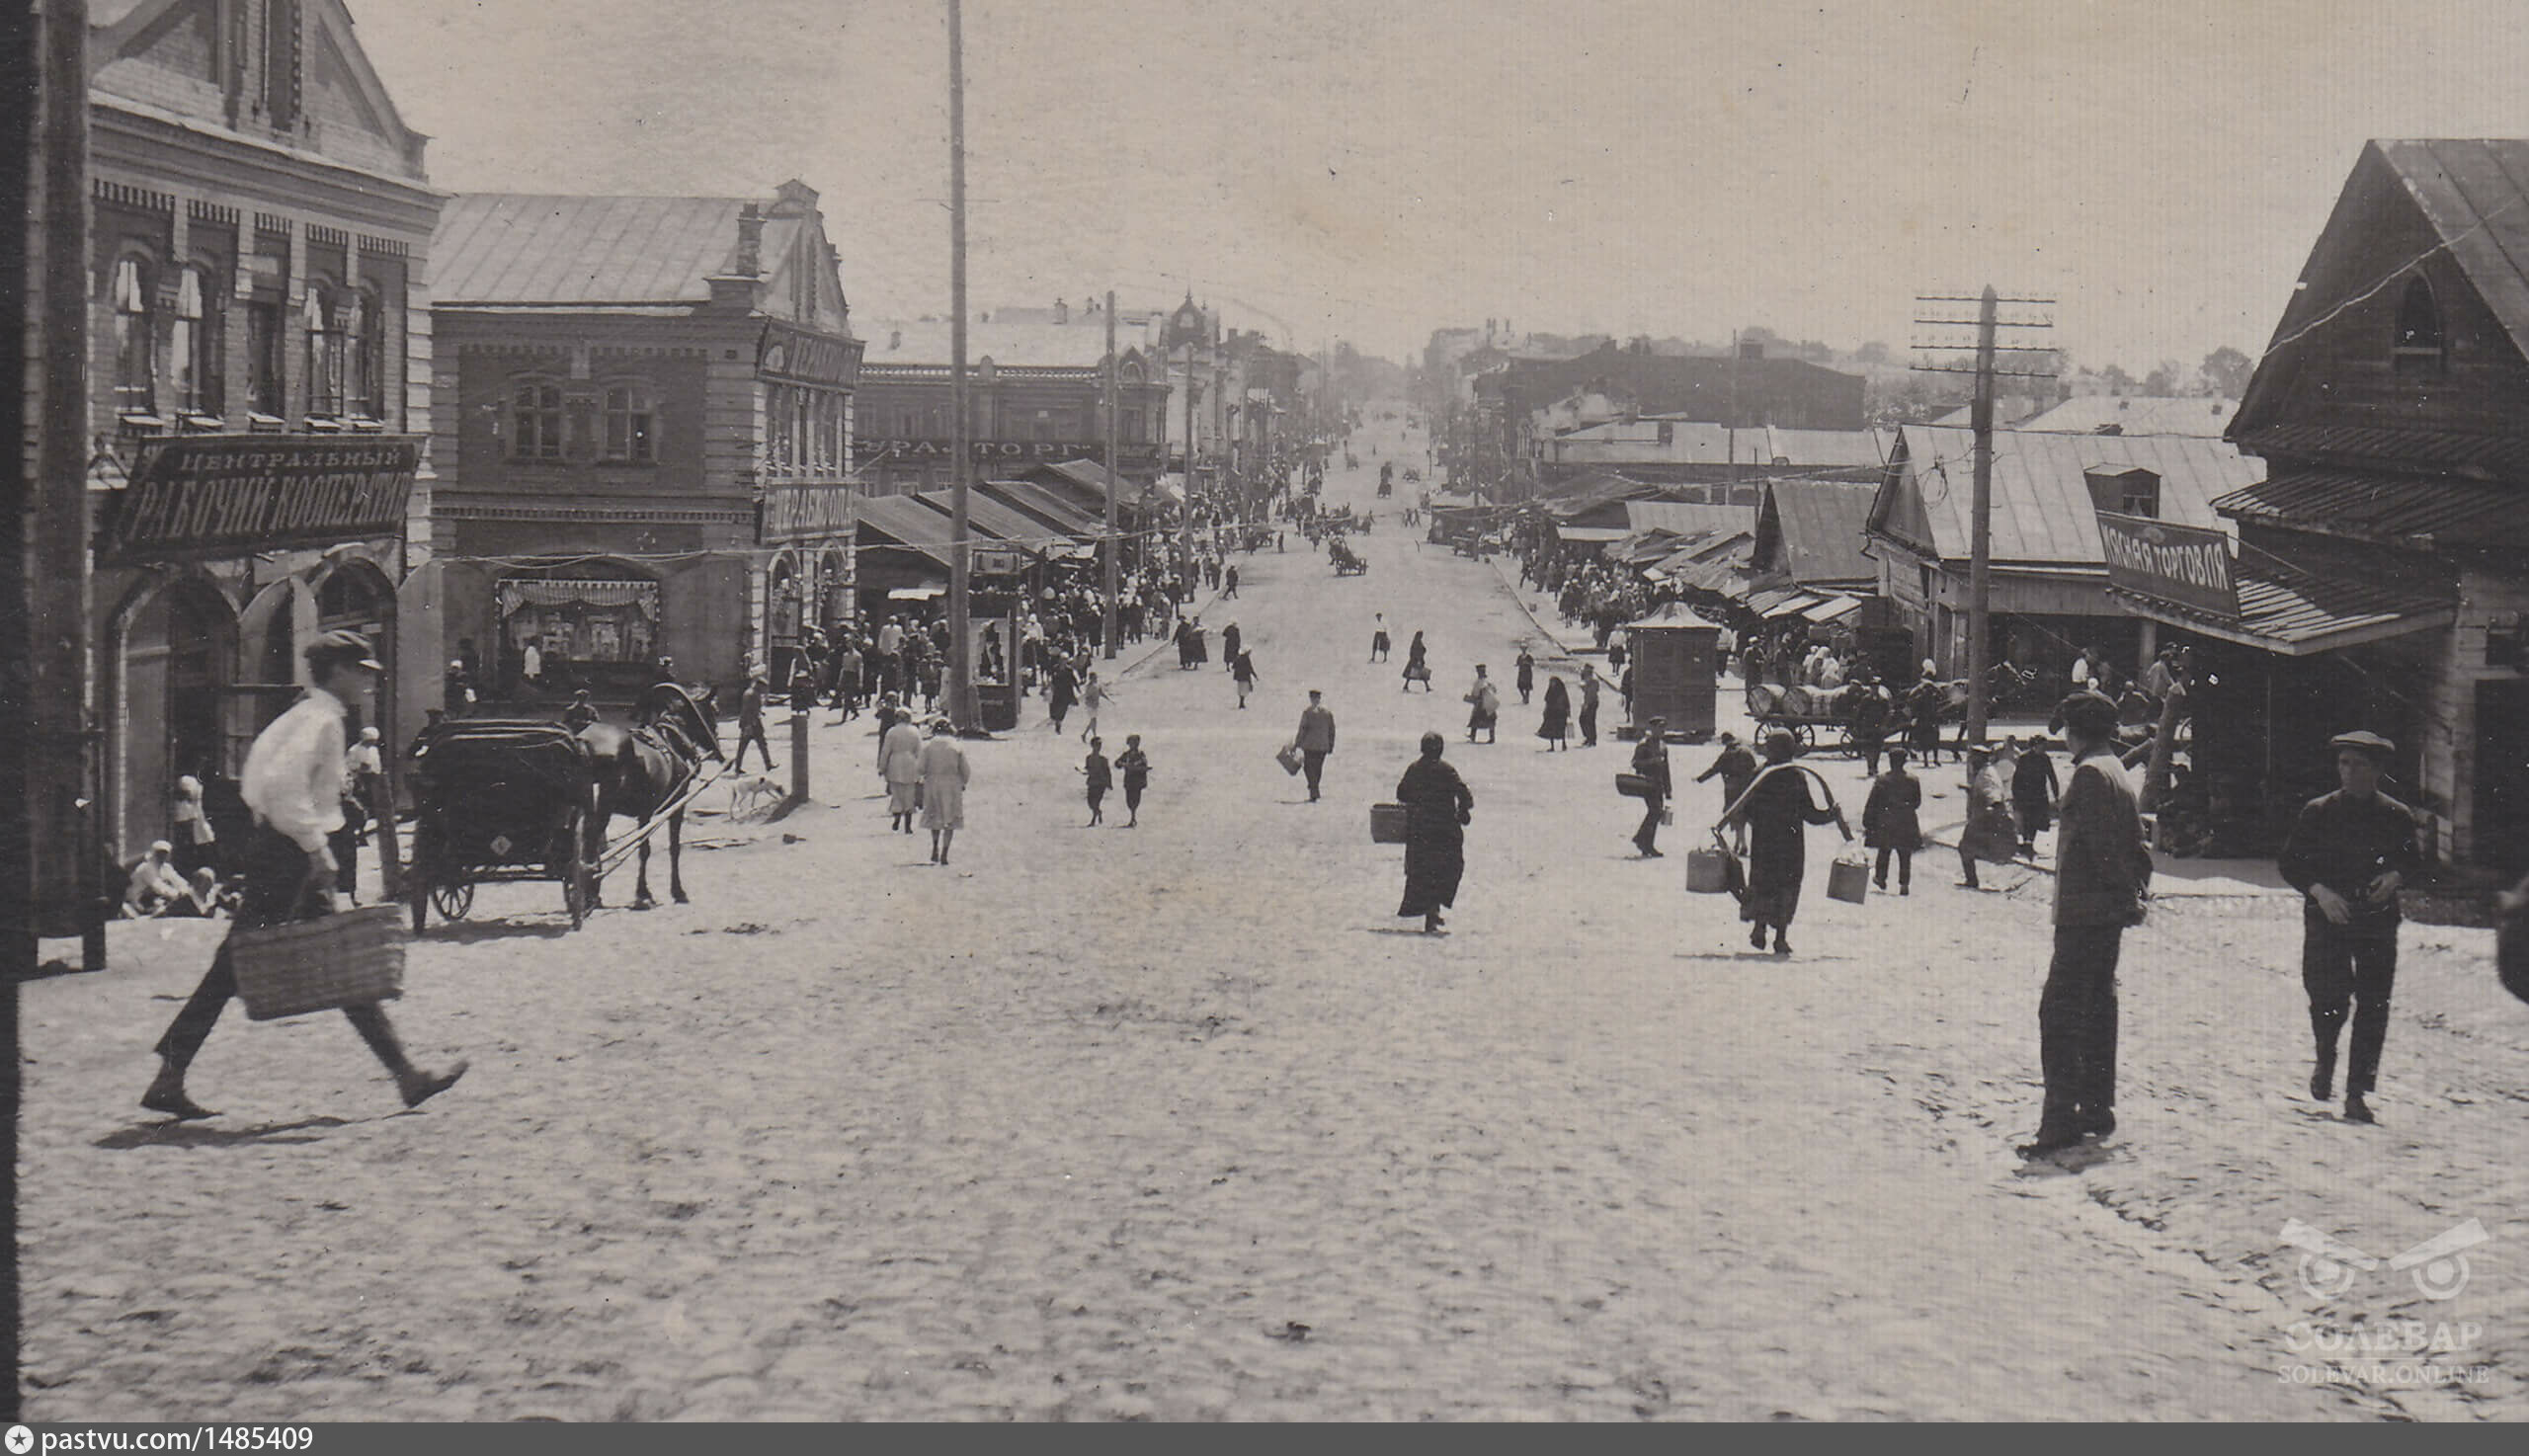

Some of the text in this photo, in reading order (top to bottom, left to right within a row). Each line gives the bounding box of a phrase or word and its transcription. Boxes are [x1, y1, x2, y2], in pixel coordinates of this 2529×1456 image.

[180, 448, 402, 472] ЦЕНТРАЛЬНЫЙ
[130, 470, 411, 538] РАБОЧИЙ КООПЕРАТИВ
[2101, 523, 2229, 591] МЯСНАЯ ТОРГОВЛЯ
